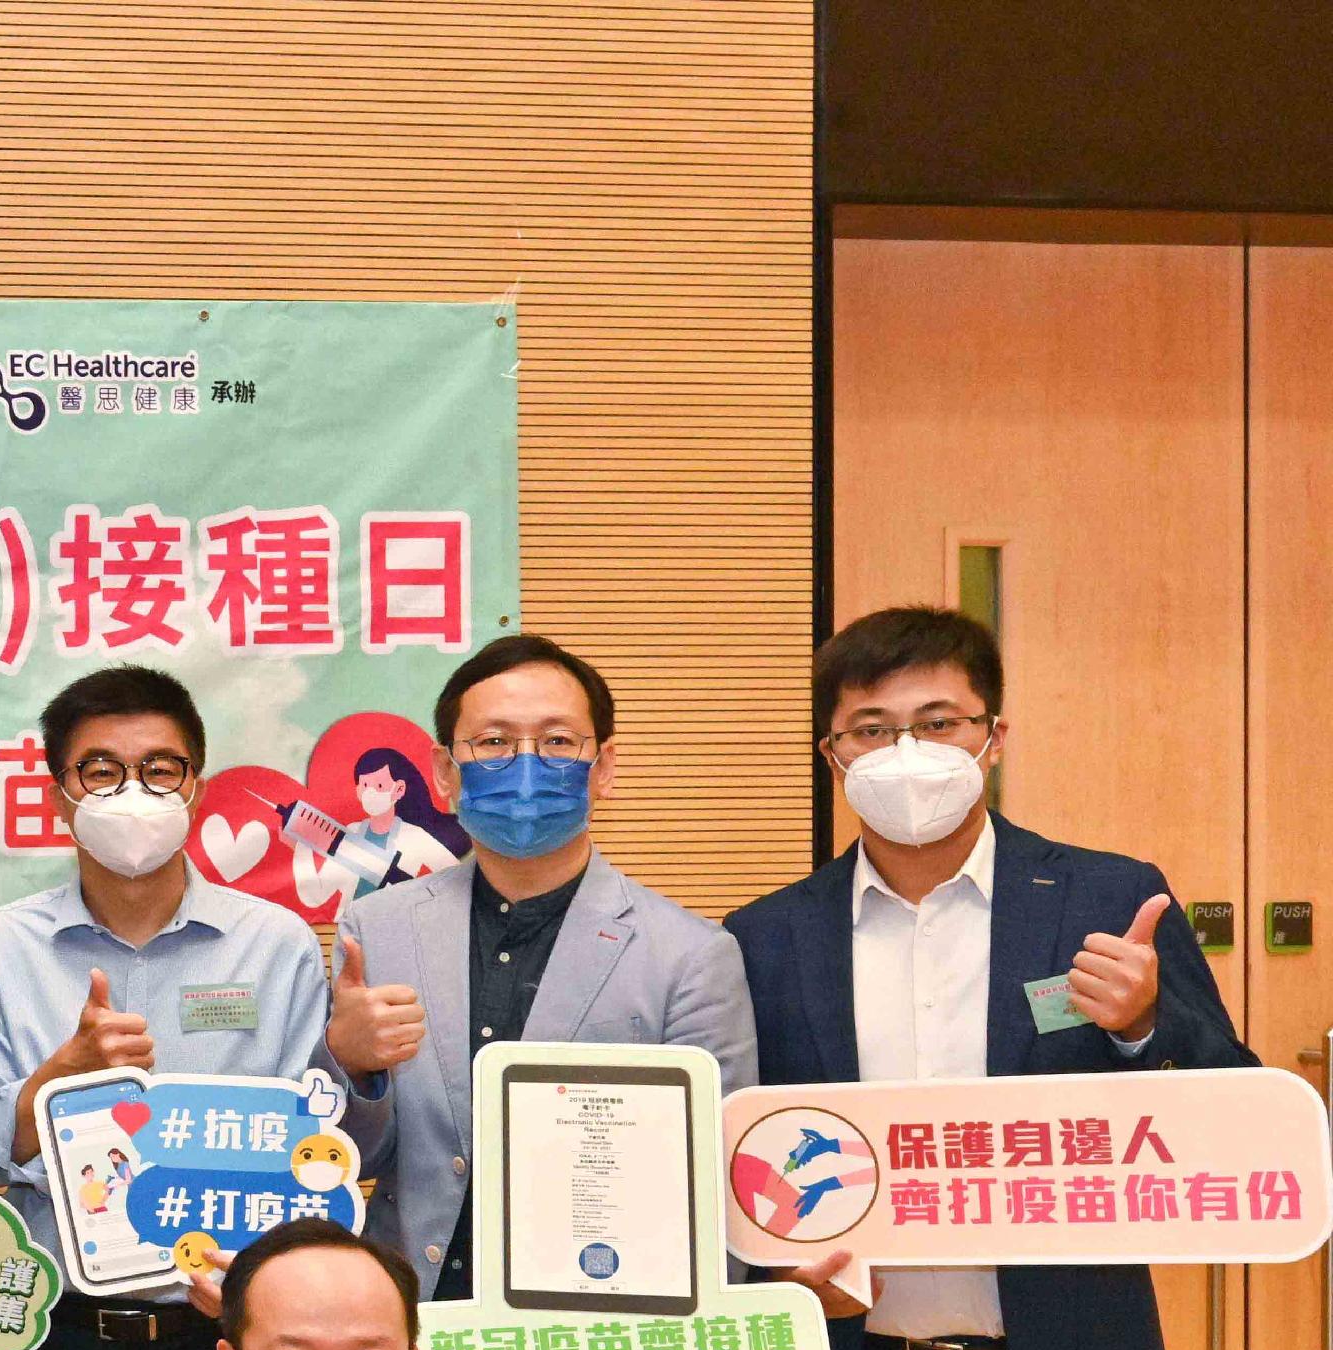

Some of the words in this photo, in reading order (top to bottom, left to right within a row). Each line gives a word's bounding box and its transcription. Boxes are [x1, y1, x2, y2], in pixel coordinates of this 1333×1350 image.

[10, 354, 44, 377] EC
[61, 386, 196, 411] 醫思健康
[211, 380, 256, 404] 承辦
[1195, 905, 1232, 918] PUSH
[1274, 905, 1311, 918] PUSH
[886, 1115, 1175, 1171] 保護身邊人
[890, 1170, 1302, 1226] 齊打疫苗你有份
